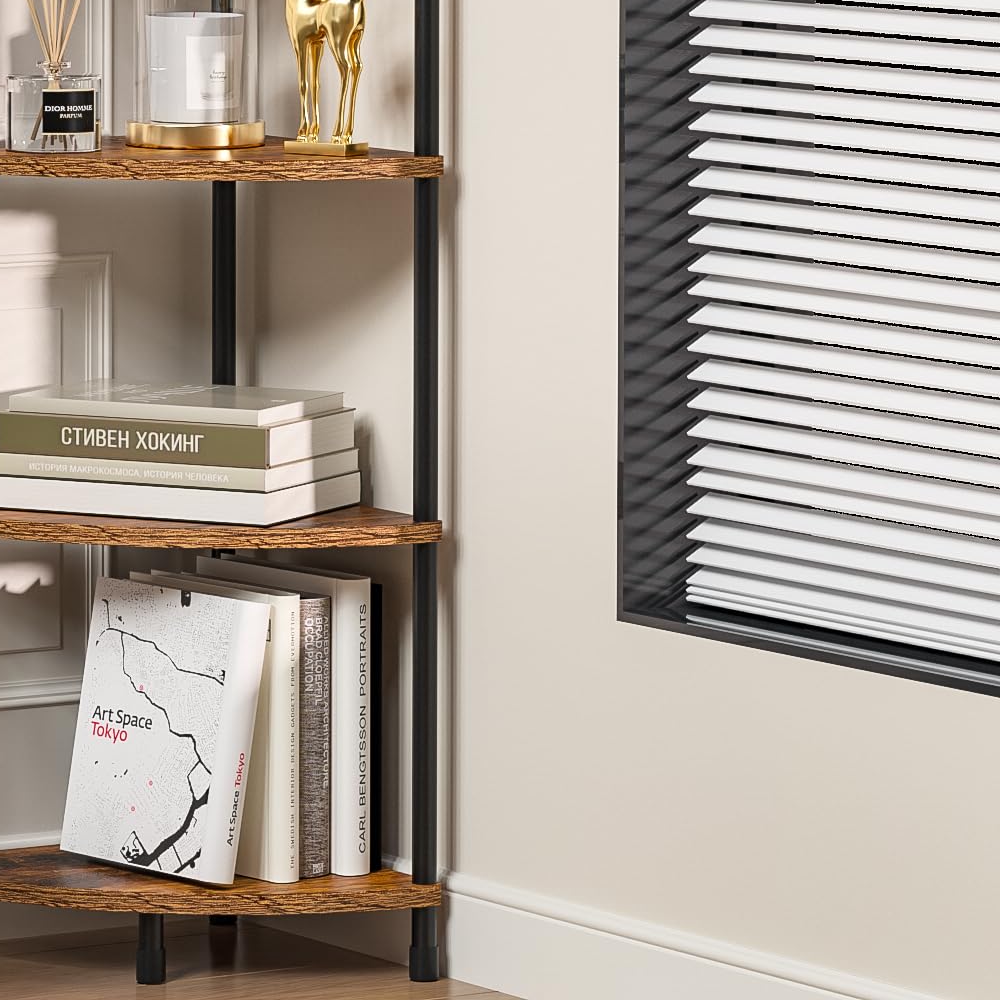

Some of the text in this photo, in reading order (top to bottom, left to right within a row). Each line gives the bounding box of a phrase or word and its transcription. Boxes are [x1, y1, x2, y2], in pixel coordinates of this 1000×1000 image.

[66, 104, 93, 112] HOMME
[60, 426, 204, 454] СТИВЕН ХОКИНГ
[28, 462, 230, 483] ИСТОРИЯ МАКРОКОСМОСА, ИСТОРИЯ ЧЕЛОВЕКА
[315, 617, 323, 649] BRAD
[305, 617, 314, 692] OCCUPATION
[92, 704, 153, 730] Art Space
[358, 603, 367, 854] CARL BENGTSSON PORTRAITS
[91, 721, 128, 744] Tokyo
[226, 753, 245, 847] Art Space Tokyo
